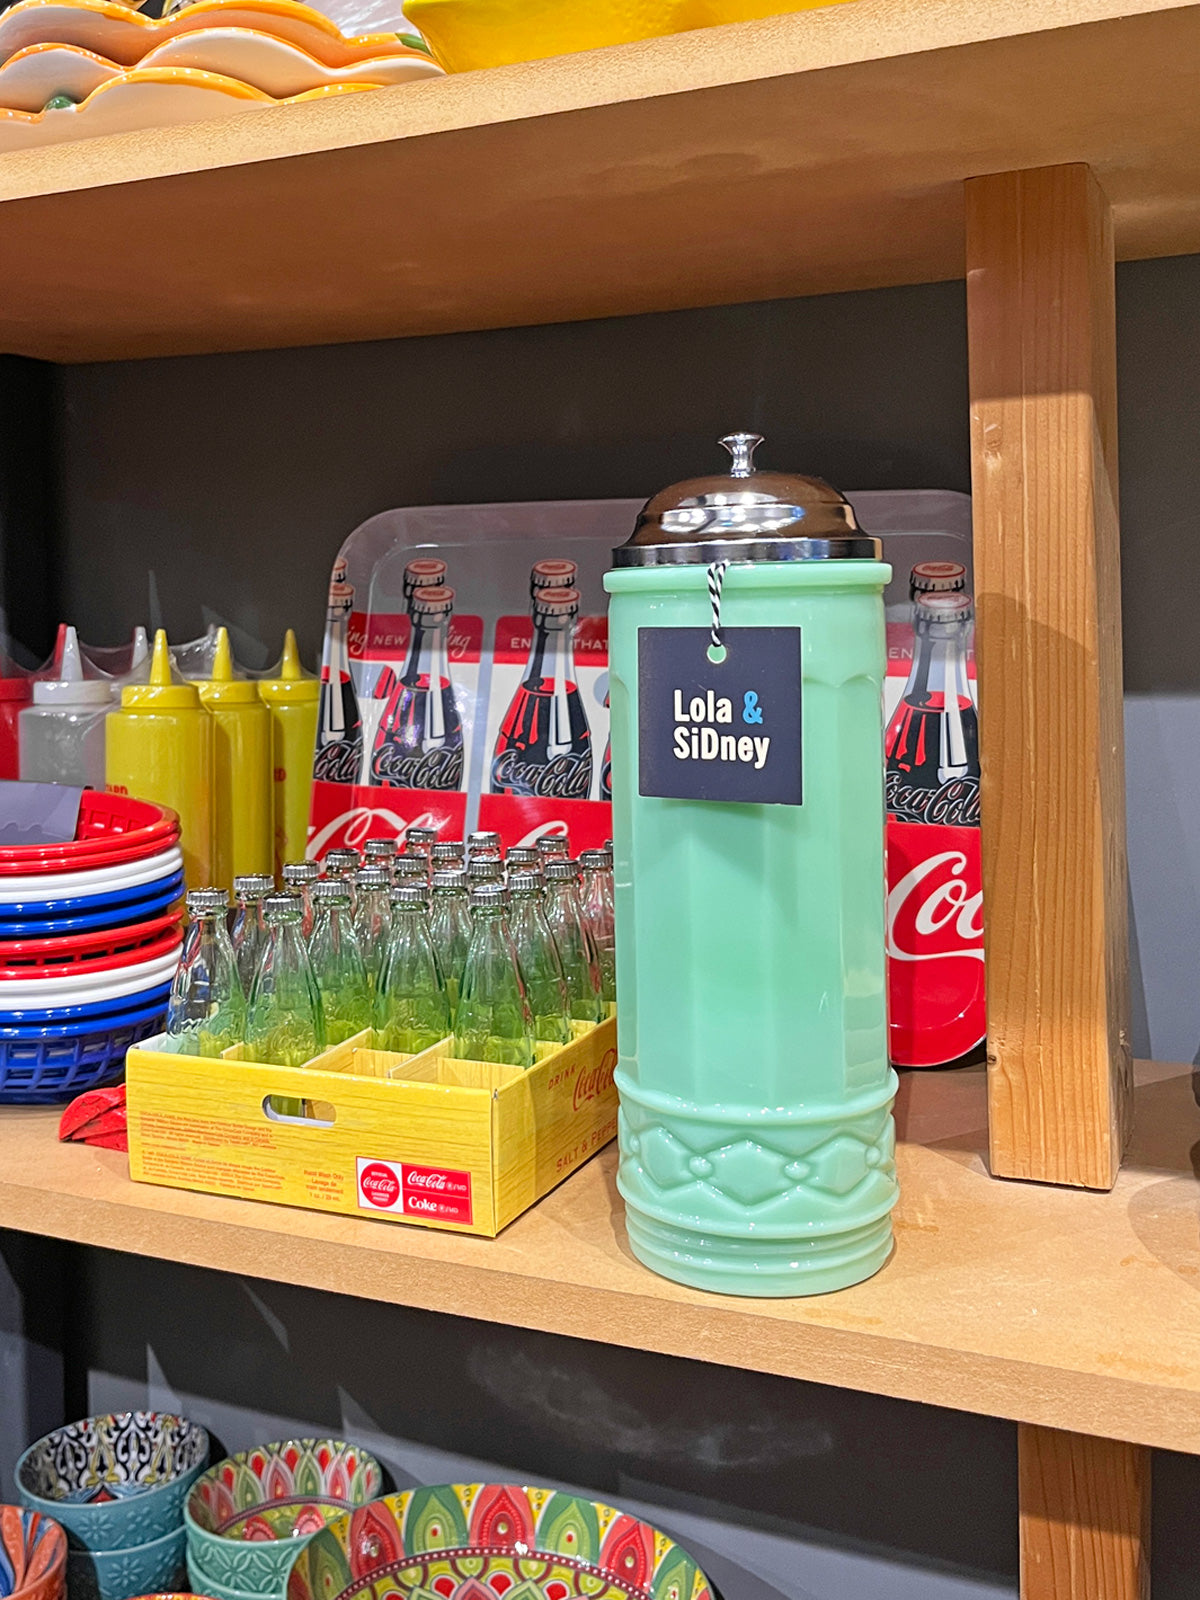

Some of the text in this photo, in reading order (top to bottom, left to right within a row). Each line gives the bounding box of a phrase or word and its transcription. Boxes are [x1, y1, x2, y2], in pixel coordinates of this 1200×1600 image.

[373, 634, 407, 646] NEW
[673, 689, 764, 724] Lola &
[673, 726, 770, 770] SiDney
[548, 1063, 576, 1090] DRINK
[556, 1117, 617, 1173] SALT & PEPPE
[407, 1170, 447, 1190] Coca-Cola
[408, 1196, 437, 1212] Coke
